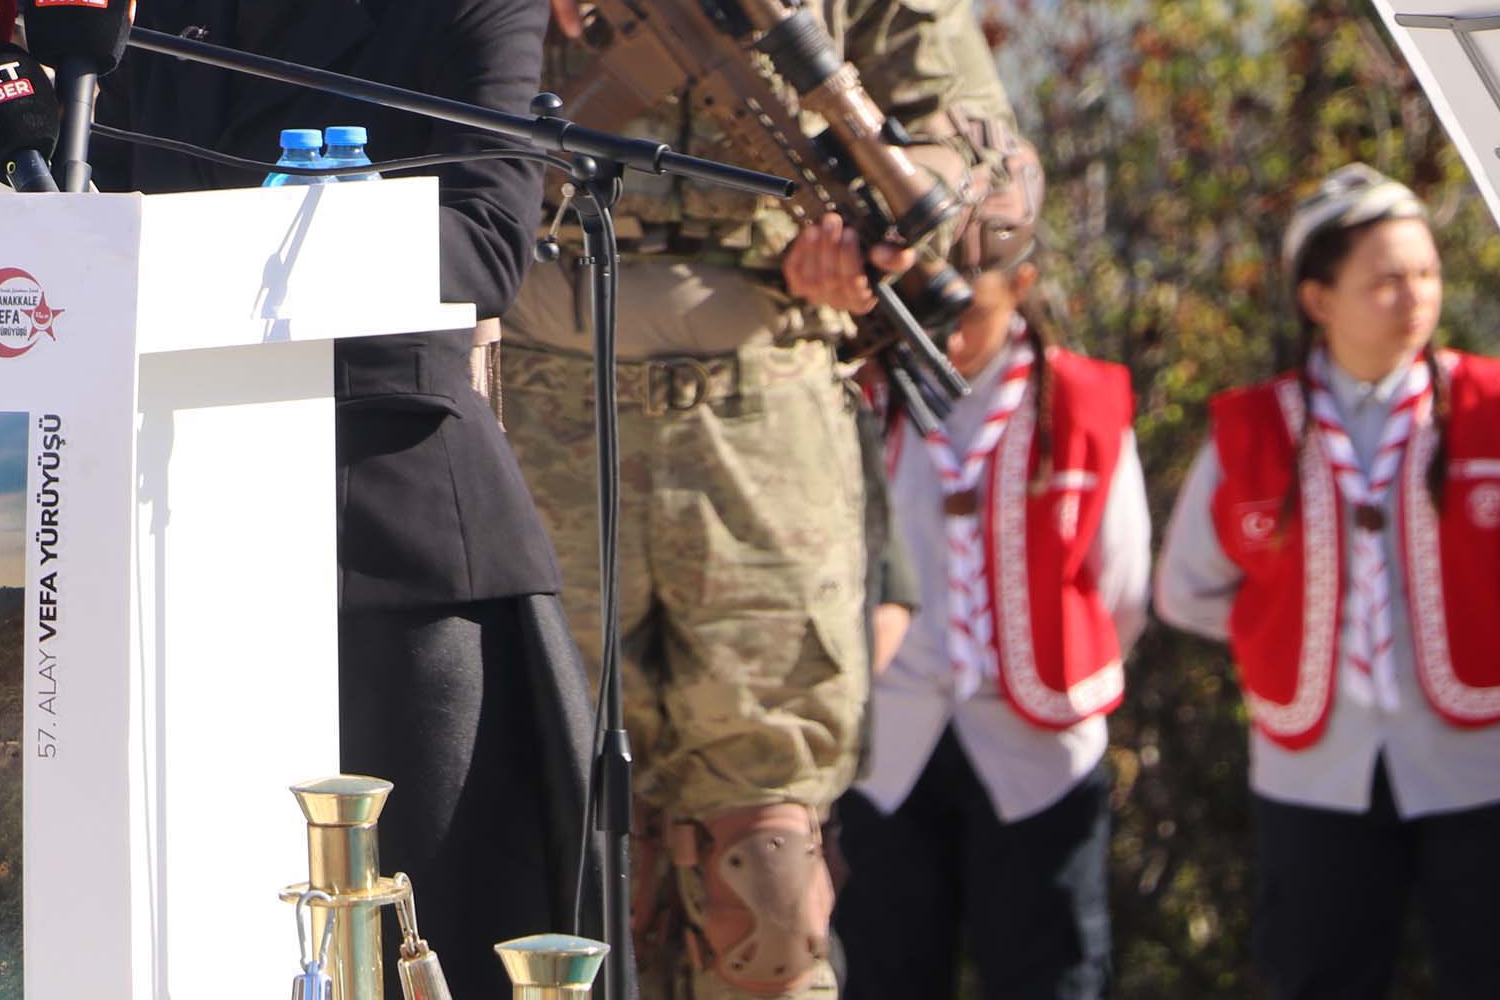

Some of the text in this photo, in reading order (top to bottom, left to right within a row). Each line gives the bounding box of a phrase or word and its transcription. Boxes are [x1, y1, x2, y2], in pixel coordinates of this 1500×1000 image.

[36, 414, 66, 758] 57. ALAY VEFA YÜRÜYÜŞÜ
